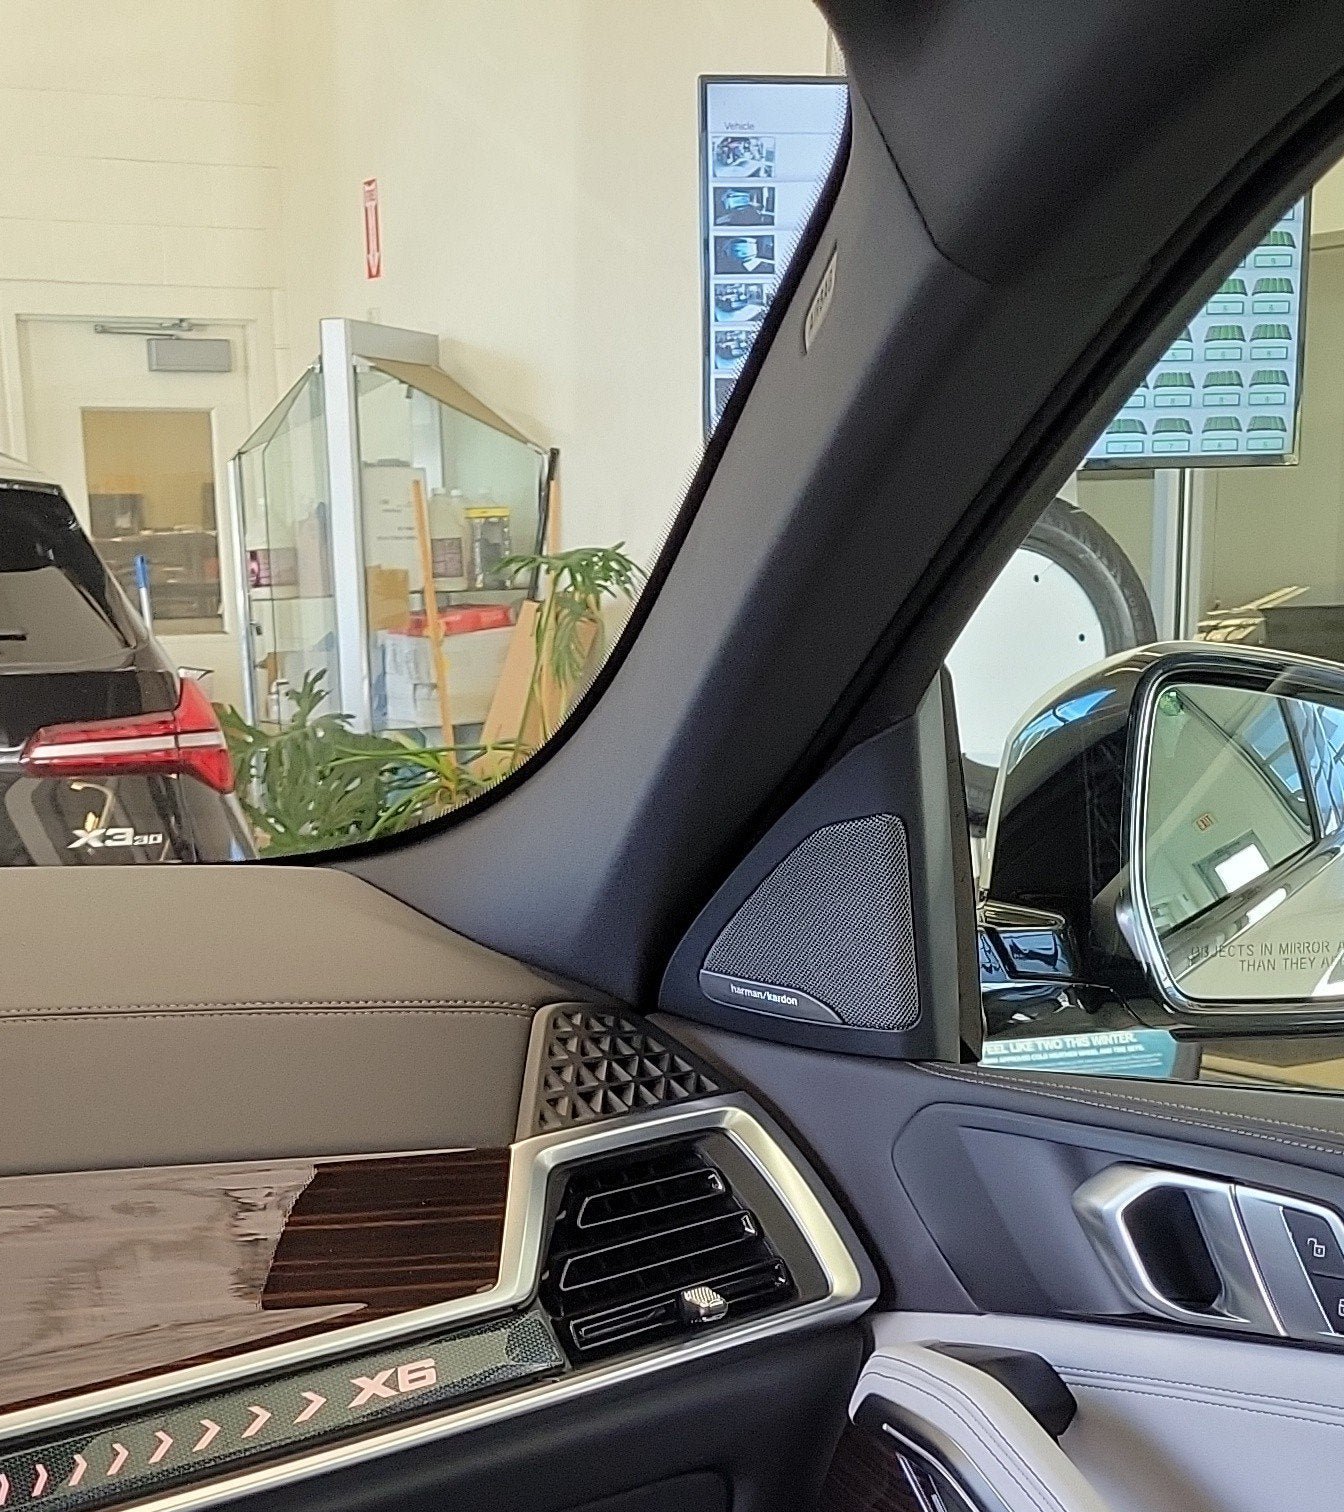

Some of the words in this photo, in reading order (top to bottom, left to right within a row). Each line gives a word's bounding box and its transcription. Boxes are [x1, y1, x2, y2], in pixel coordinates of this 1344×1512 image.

[723, 121, 754, 131] Vehicle
[1192, 944, 1254, 959] OBJECTS
[1260, 943, 1273, 956] IN
[1279, 941, 1330, 955] MIRROR
[1239, 959, 1276, 972] THAN
[1282, 957, 1317, 970] THEY
[730, 984, 798, 1006] harman/kardon
[1009, 1040, 1035, 1053] LIKE
[1037, 1038, 1063, 1051] TWO
[1064, 1036, 1090, 1049] THIS
[348, 1358, 437, 1409] X6
